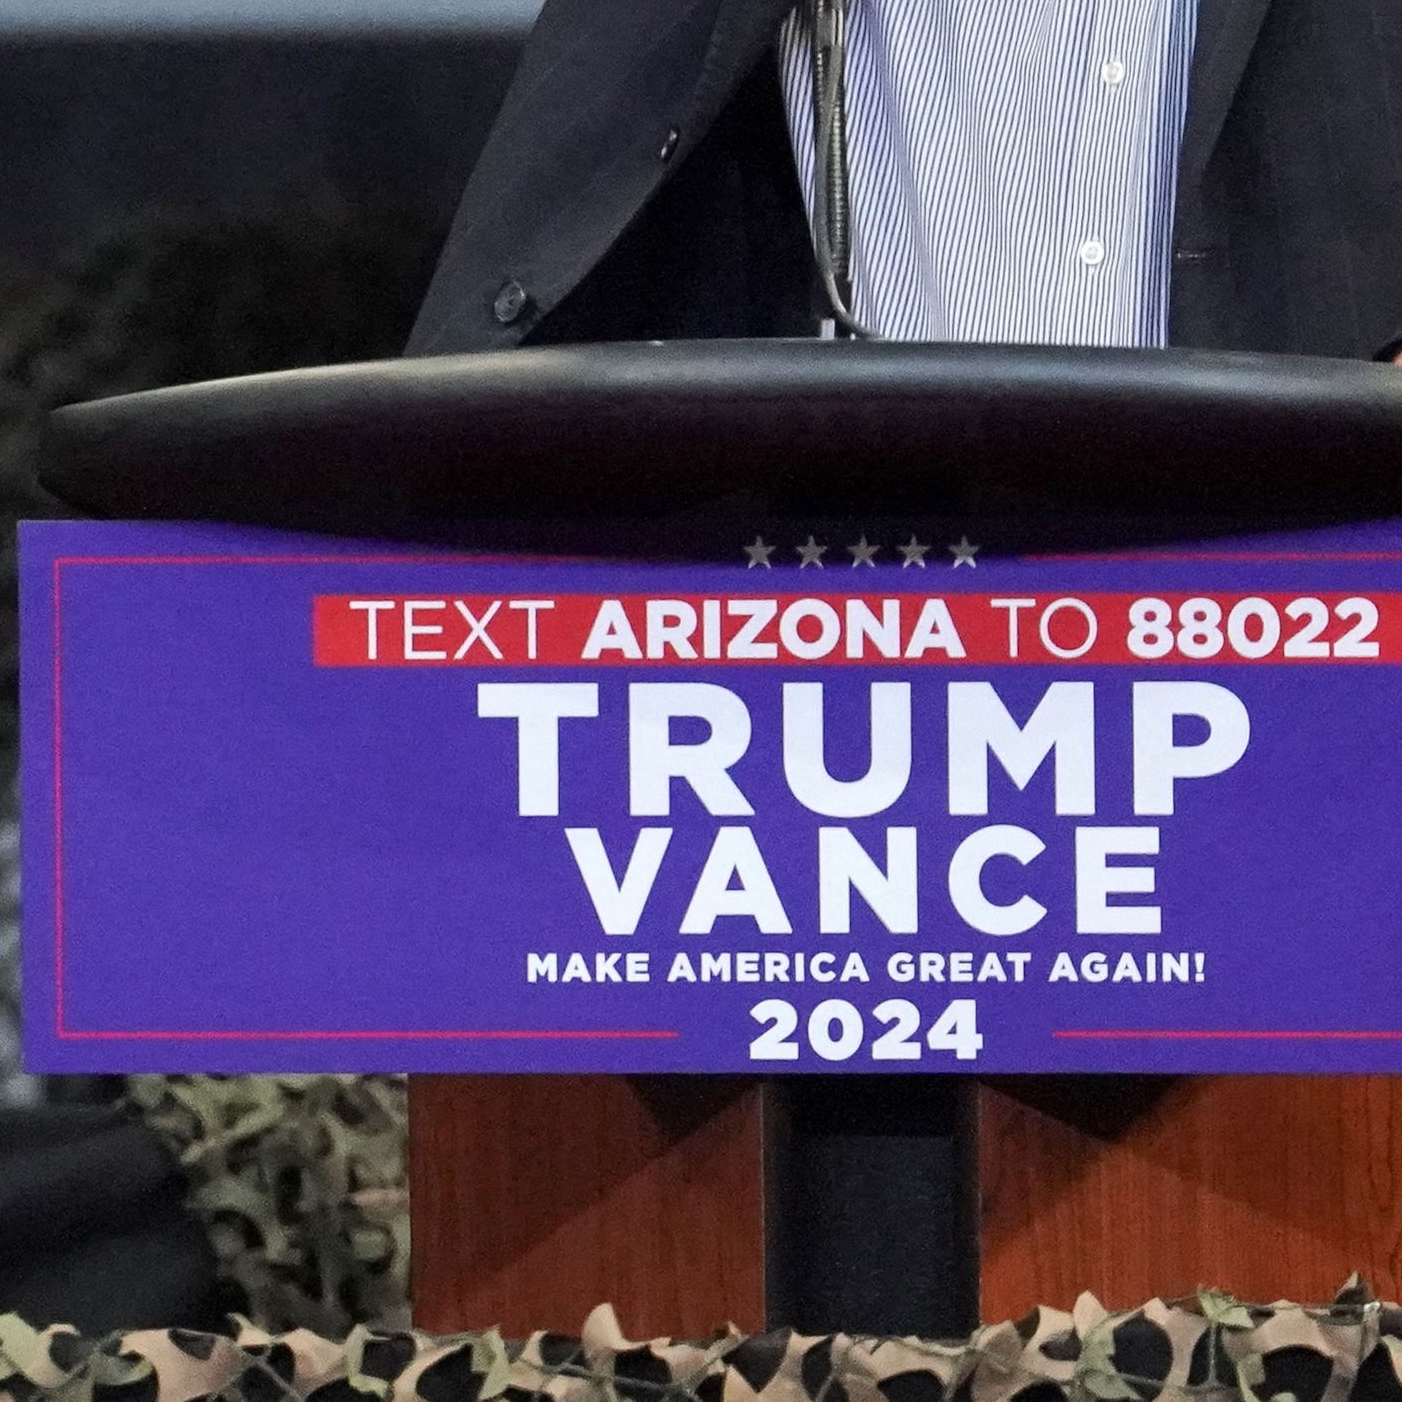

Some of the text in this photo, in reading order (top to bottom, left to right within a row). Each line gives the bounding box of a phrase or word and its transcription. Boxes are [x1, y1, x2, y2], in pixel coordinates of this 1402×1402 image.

[348, 596, 1380, 660] TEXT ARIZONA TO 88022
[477, 681, 1251, 819] TRUMP
[564, 824, 1162, 937] VANCE
[526, 951, 1205, 983] MAKE AMERICA GREAT AGAIN!
[749, 998, 984, 1061] 2024
